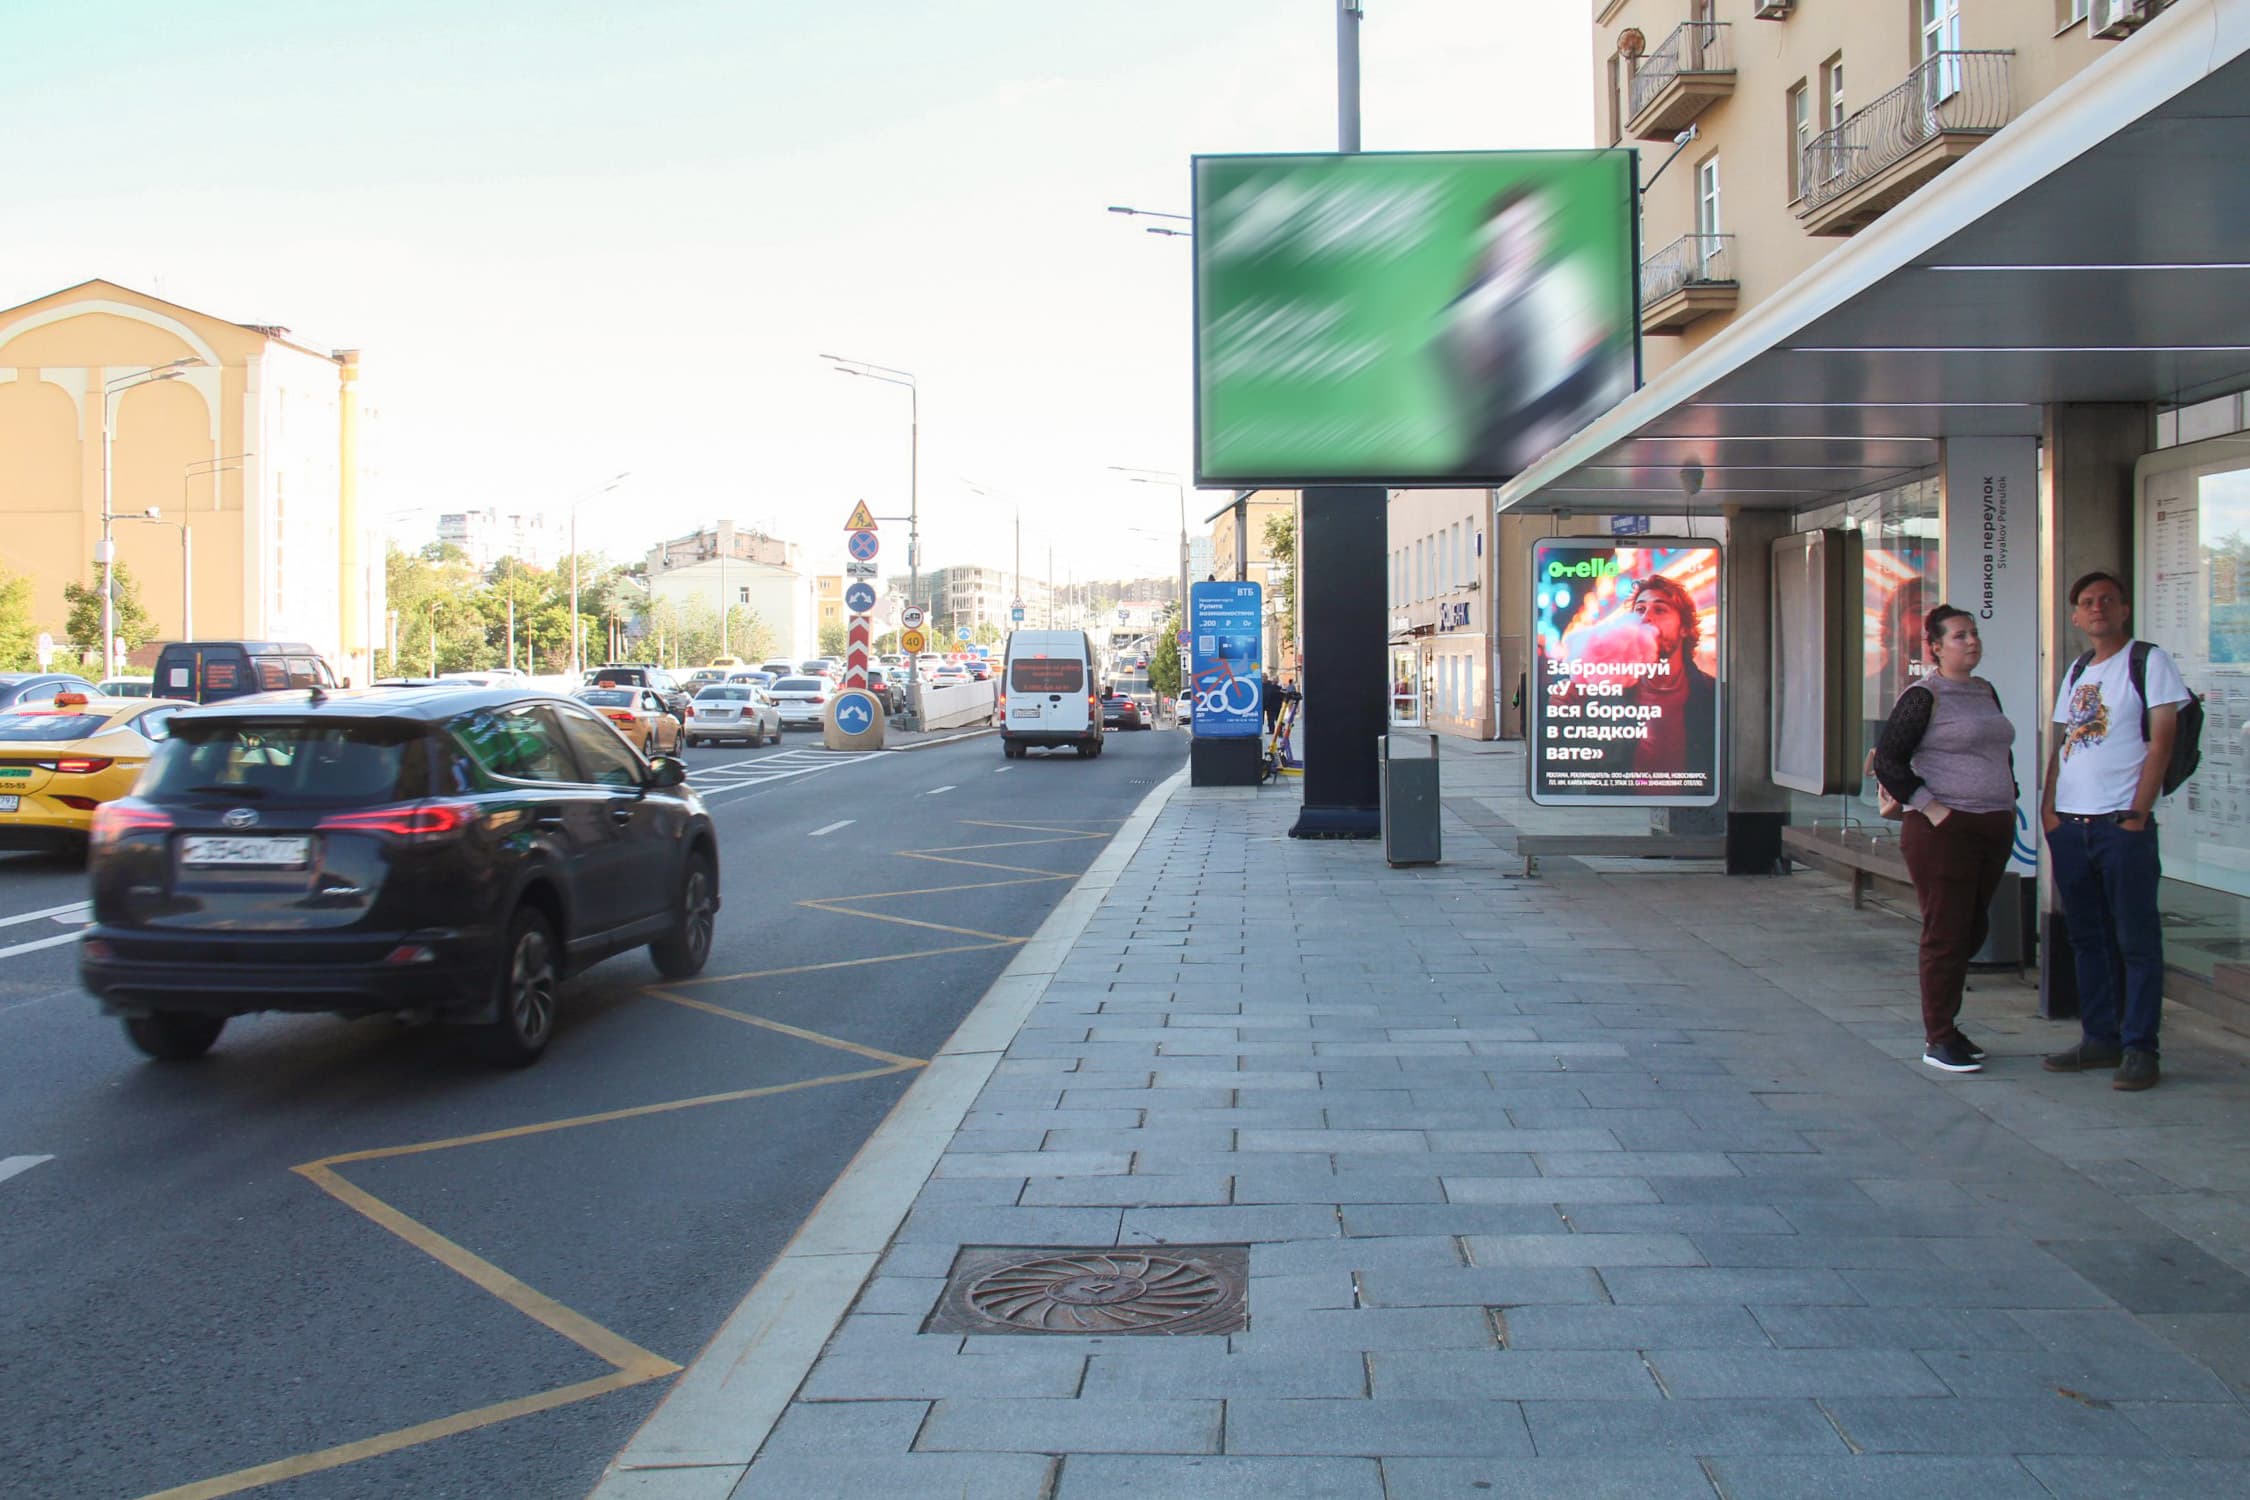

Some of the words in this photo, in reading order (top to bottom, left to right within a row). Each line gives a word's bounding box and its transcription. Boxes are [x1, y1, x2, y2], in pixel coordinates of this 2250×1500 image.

[1998, 476, 2007, 522] Pereulok
[1983, 476, 1996, 550] переулок
[1998, 525, 2008, 569] Sivyakov
[1237, 587, 1254, 597] ВТБ
[1981, 555, 1994, 619] Сивяков
[906, 637, 920, 647] 40
[1546, 658, 1671, 679] Забронируй
[1547, 679, 1571, 696] «У
[1575, 679, 1624, 697] тебя
[1546, 705, 1581, 718] вся
[1585, 701, 1663, 721] борода
[1546, 725, 1559, 739] в
[1563, 722, 1648, 741] сладкой
[1546, 746, 1604, 761] вате»
